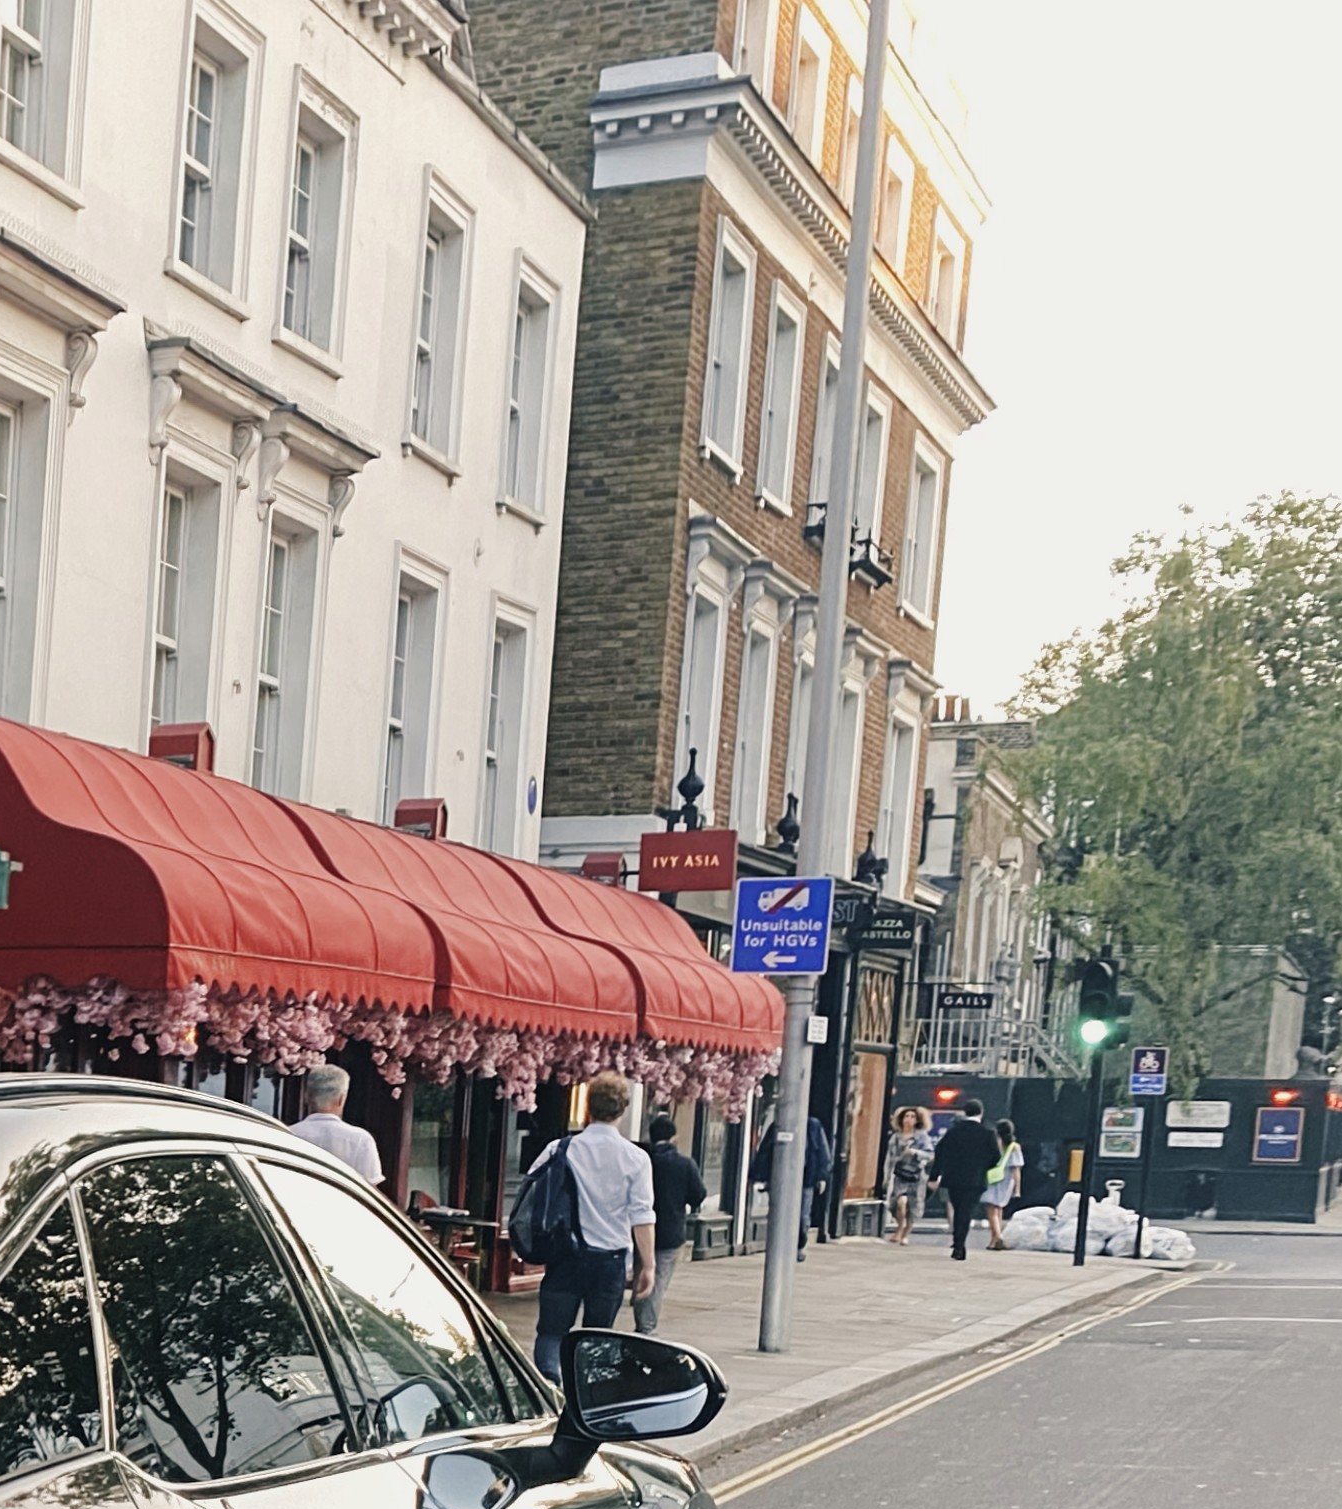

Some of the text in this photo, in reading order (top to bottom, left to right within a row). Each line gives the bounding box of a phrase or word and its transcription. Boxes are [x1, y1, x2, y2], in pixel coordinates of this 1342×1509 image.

[653, 855, 720, 868] IVY ASIA
[832, 899, 860, 922] ST
[741, 919, 822, 931] Unsuitable
[873, 920, 903, 928] AZZA
[744, 934, 817, 947] for HGVs
[861, 930, 911, 939] ASTELLO
